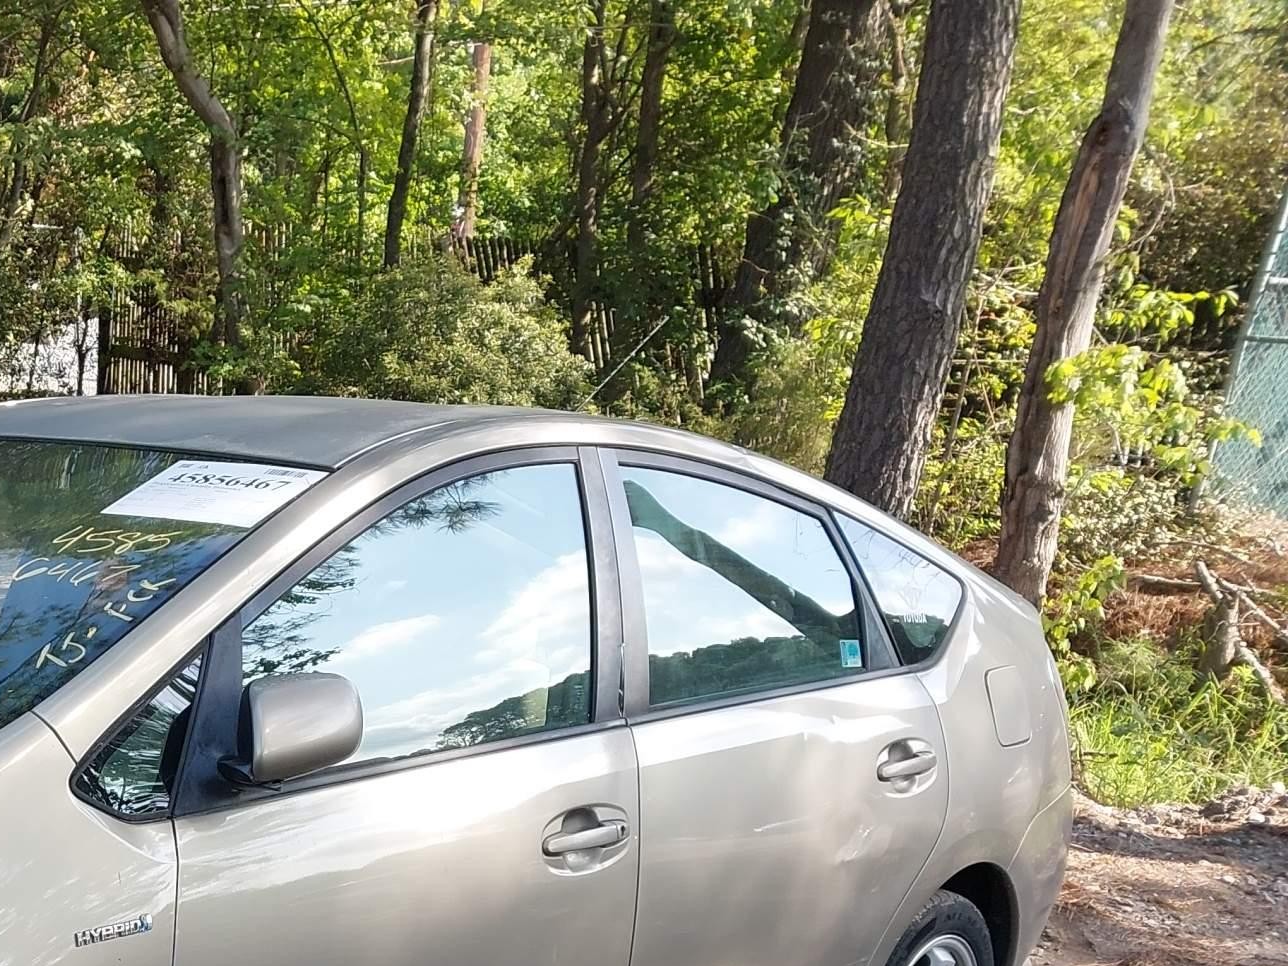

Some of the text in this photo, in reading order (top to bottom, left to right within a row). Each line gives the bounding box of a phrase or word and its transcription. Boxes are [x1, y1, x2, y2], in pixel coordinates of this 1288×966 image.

[168, 472, 292, 491] 45856467
[52, 525, 183, 555] 4585
[12, 557, 142, 587] 6467
